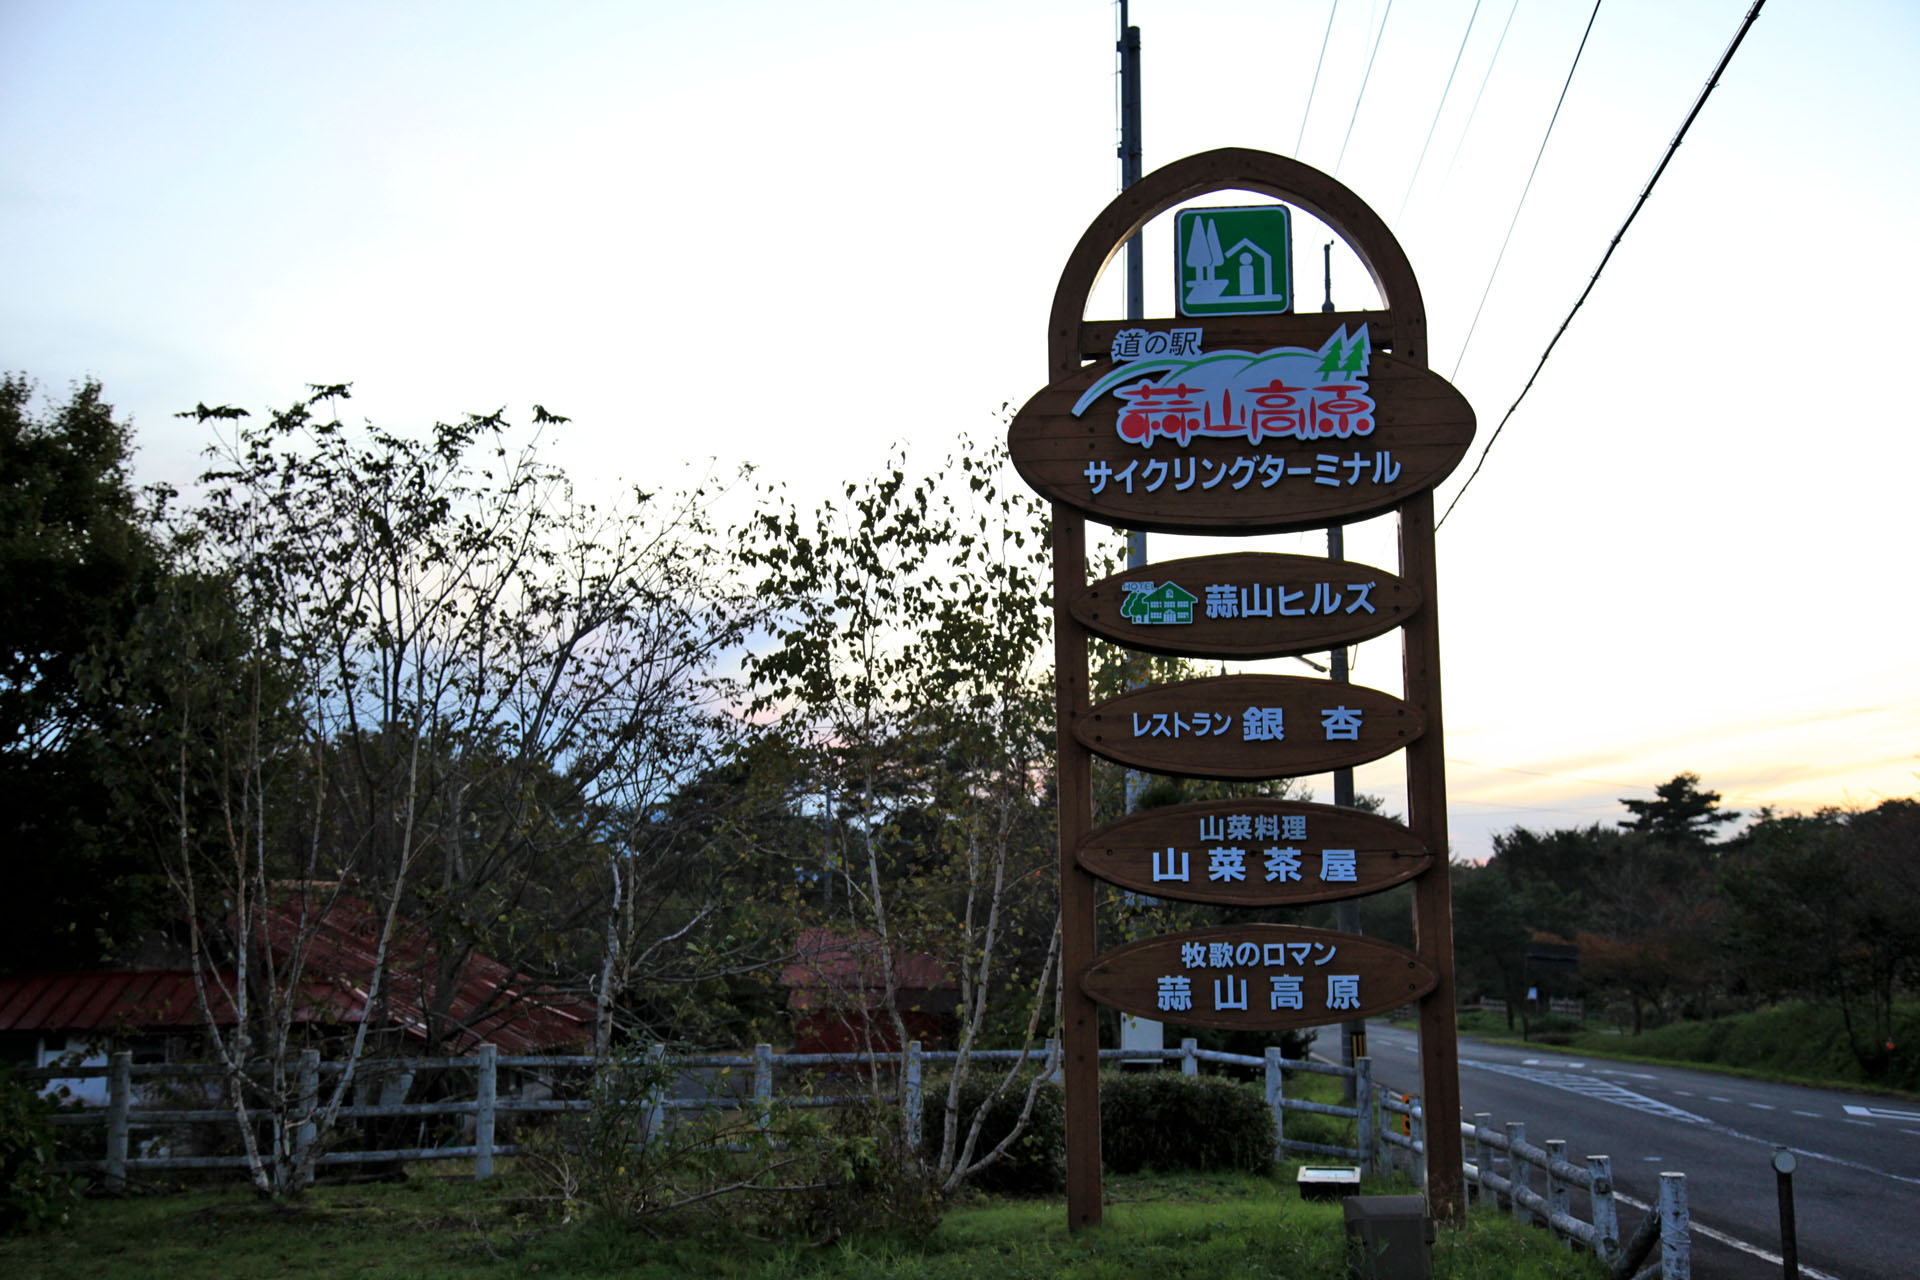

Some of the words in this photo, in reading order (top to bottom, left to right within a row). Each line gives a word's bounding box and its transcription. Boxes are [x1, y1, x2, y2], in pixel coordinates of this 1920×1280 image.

[1114, 331, 1197, 358] 道の駅
[1119, 379, 1372, 441] 蒜山高原
[1084, 451, 1401, 494] サイクリングターミナル
[1122, 582, 1155, 591] HOTEL
[1205, 582, 1376, 618] 蒜山ヒルズ
[1132, 712, 1232, 738] レストラン
[1200, 815, 1307, 841] 山菜料理
[1181, 942, 1337, 969] 牧歌のロマン
